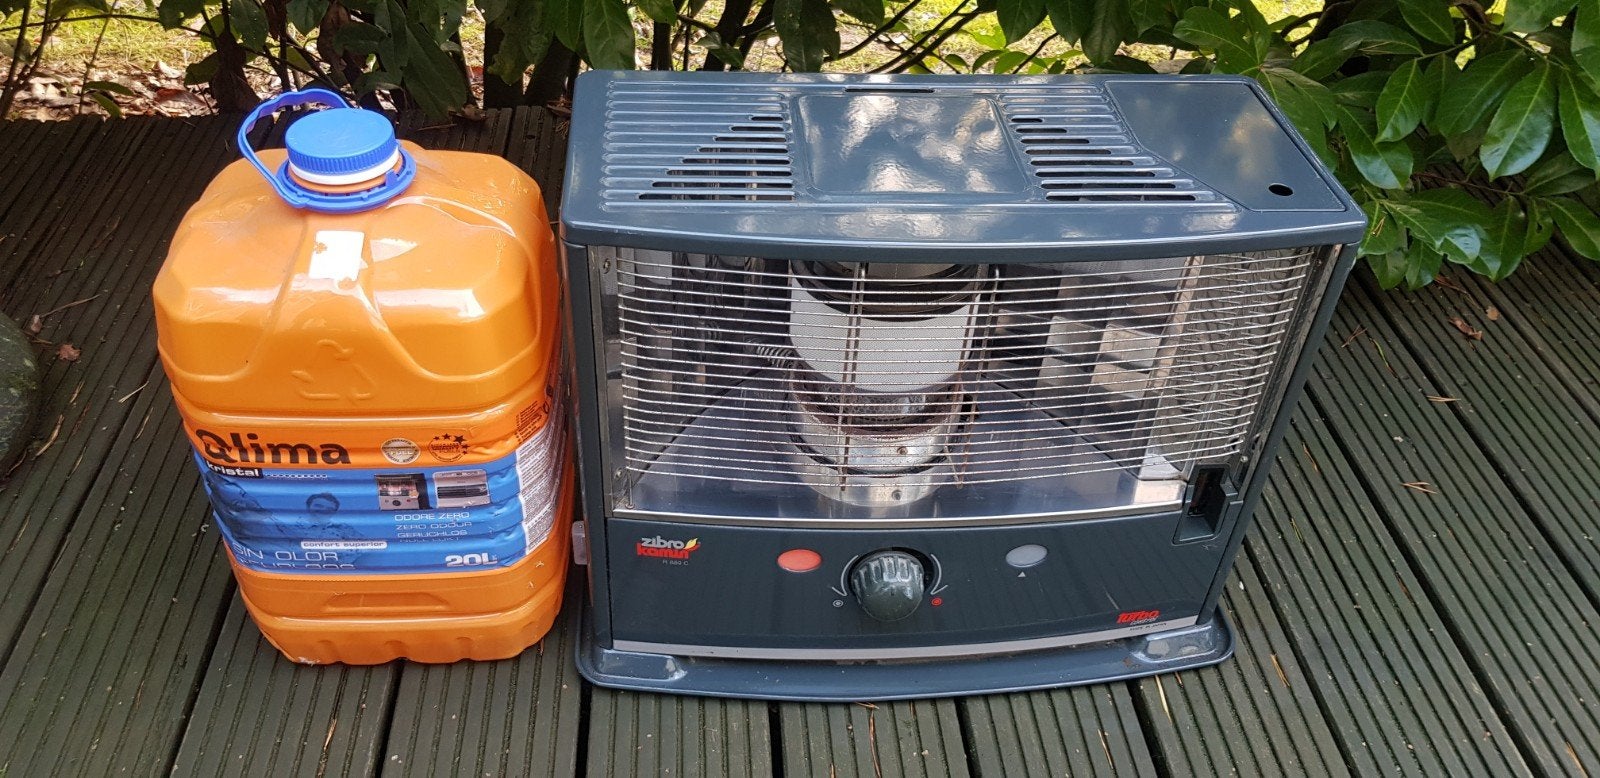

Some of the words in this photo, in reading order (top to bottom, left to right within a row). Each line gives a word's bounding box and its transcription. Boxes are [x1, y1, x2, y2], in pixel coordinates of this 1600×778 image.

[196, 429, 351, 464] Qlima
[207, 460, 260, 477] kristal
[394, 513, 436, 522] ODORE
[438, 511, 471, 520] ZERO
[430, 521, 473, 529] ODOUR
[397, 529, 468, 538] GERUCHLOS
[641, 535, 685, 550] zibro
[231, 541, 264, 560] SIN
[275, 551, 339, 562] OLOR
[636, 542, 690, 559] kamin
[445, 552, 498, 567] 20L
